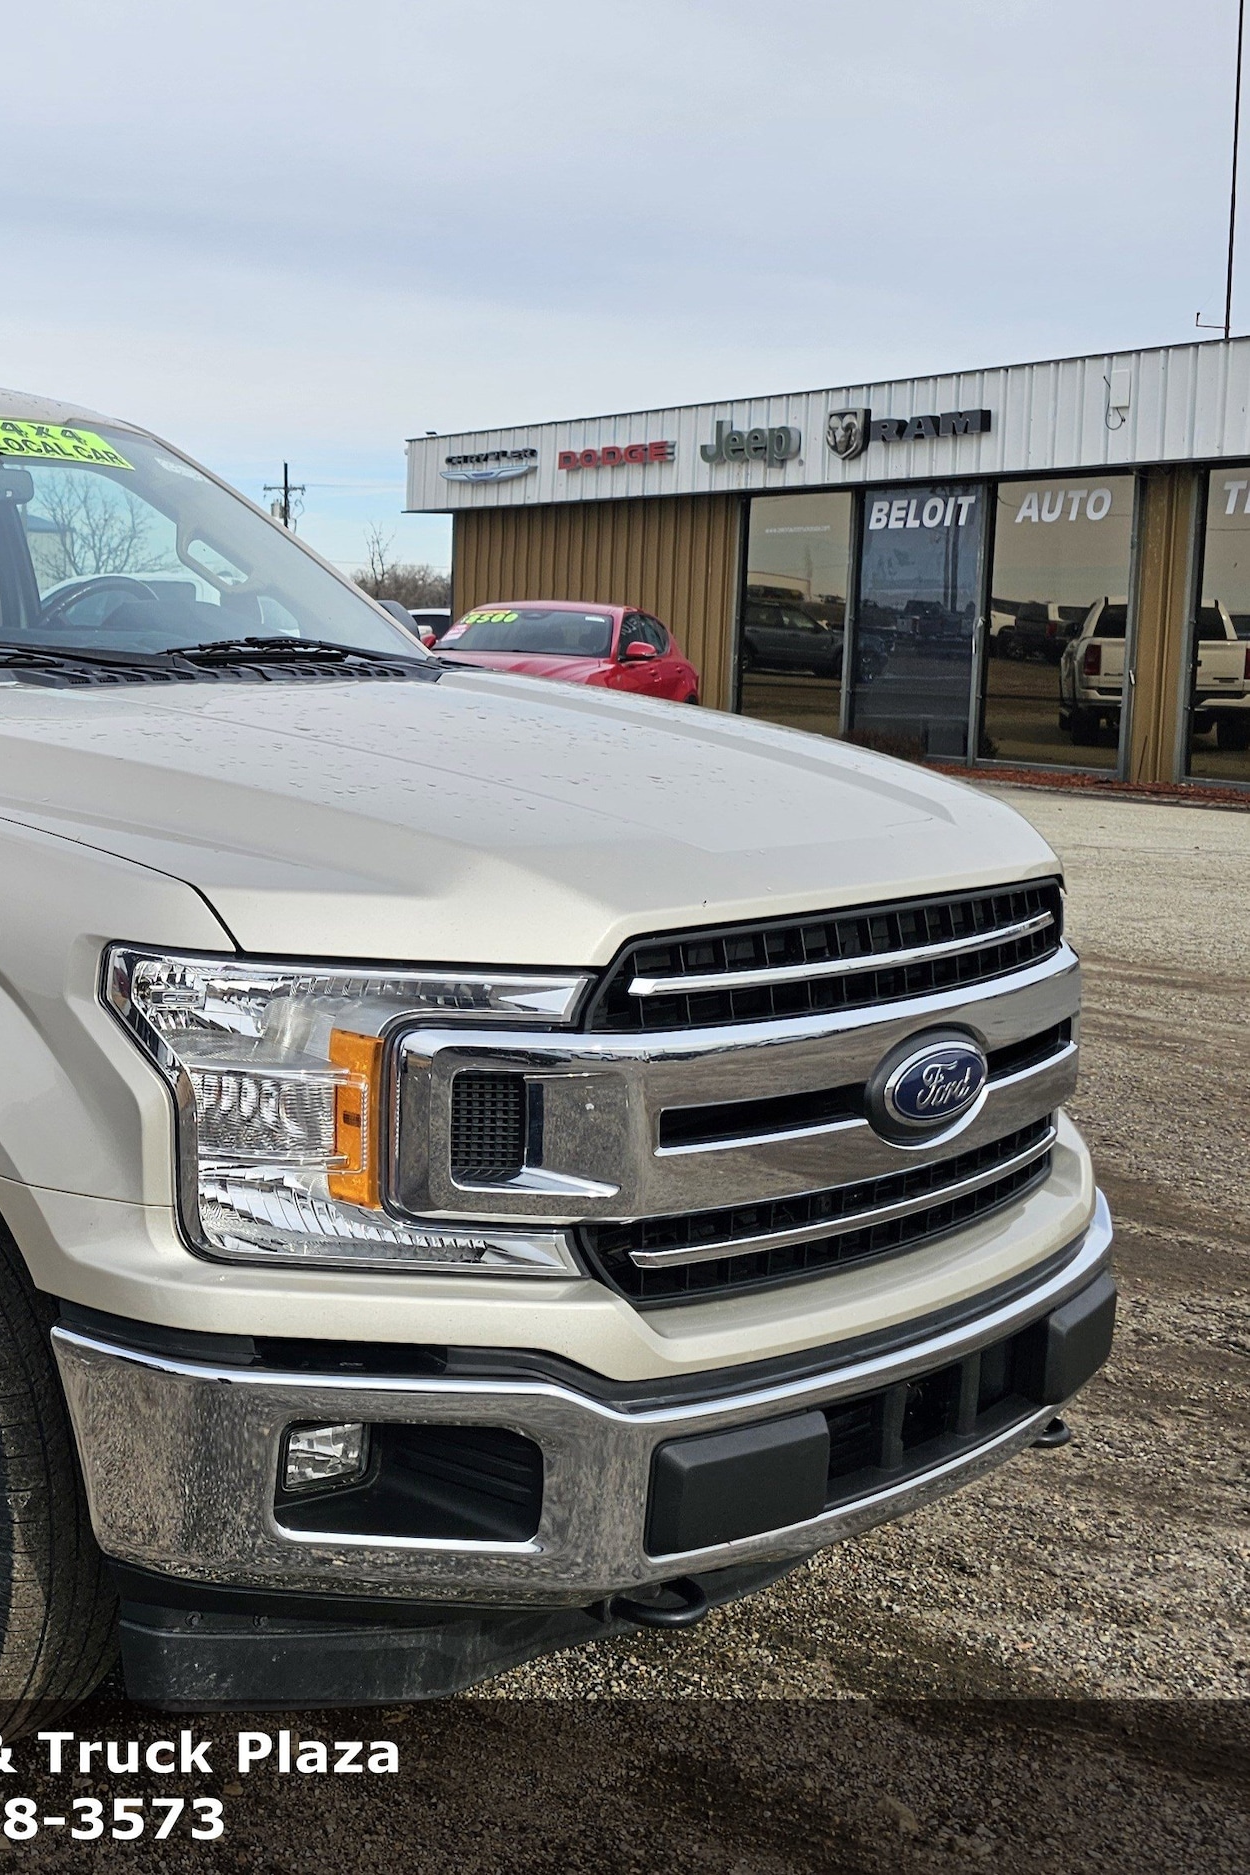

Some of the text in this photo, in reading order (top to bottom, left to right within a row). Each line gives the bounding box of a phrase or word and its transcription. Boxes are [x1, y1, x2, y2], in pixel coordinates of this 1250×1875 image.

[699, 419, 802, 469] Jeep
[869, 408, 992, 443] RAM
[72, 444, 125, 465] CAR
[557, 440, 675, 471] DODGE
[868, 479, 1250, 531] BELOIT AUTO T
[915, 1059, 973, 1112] Ford
